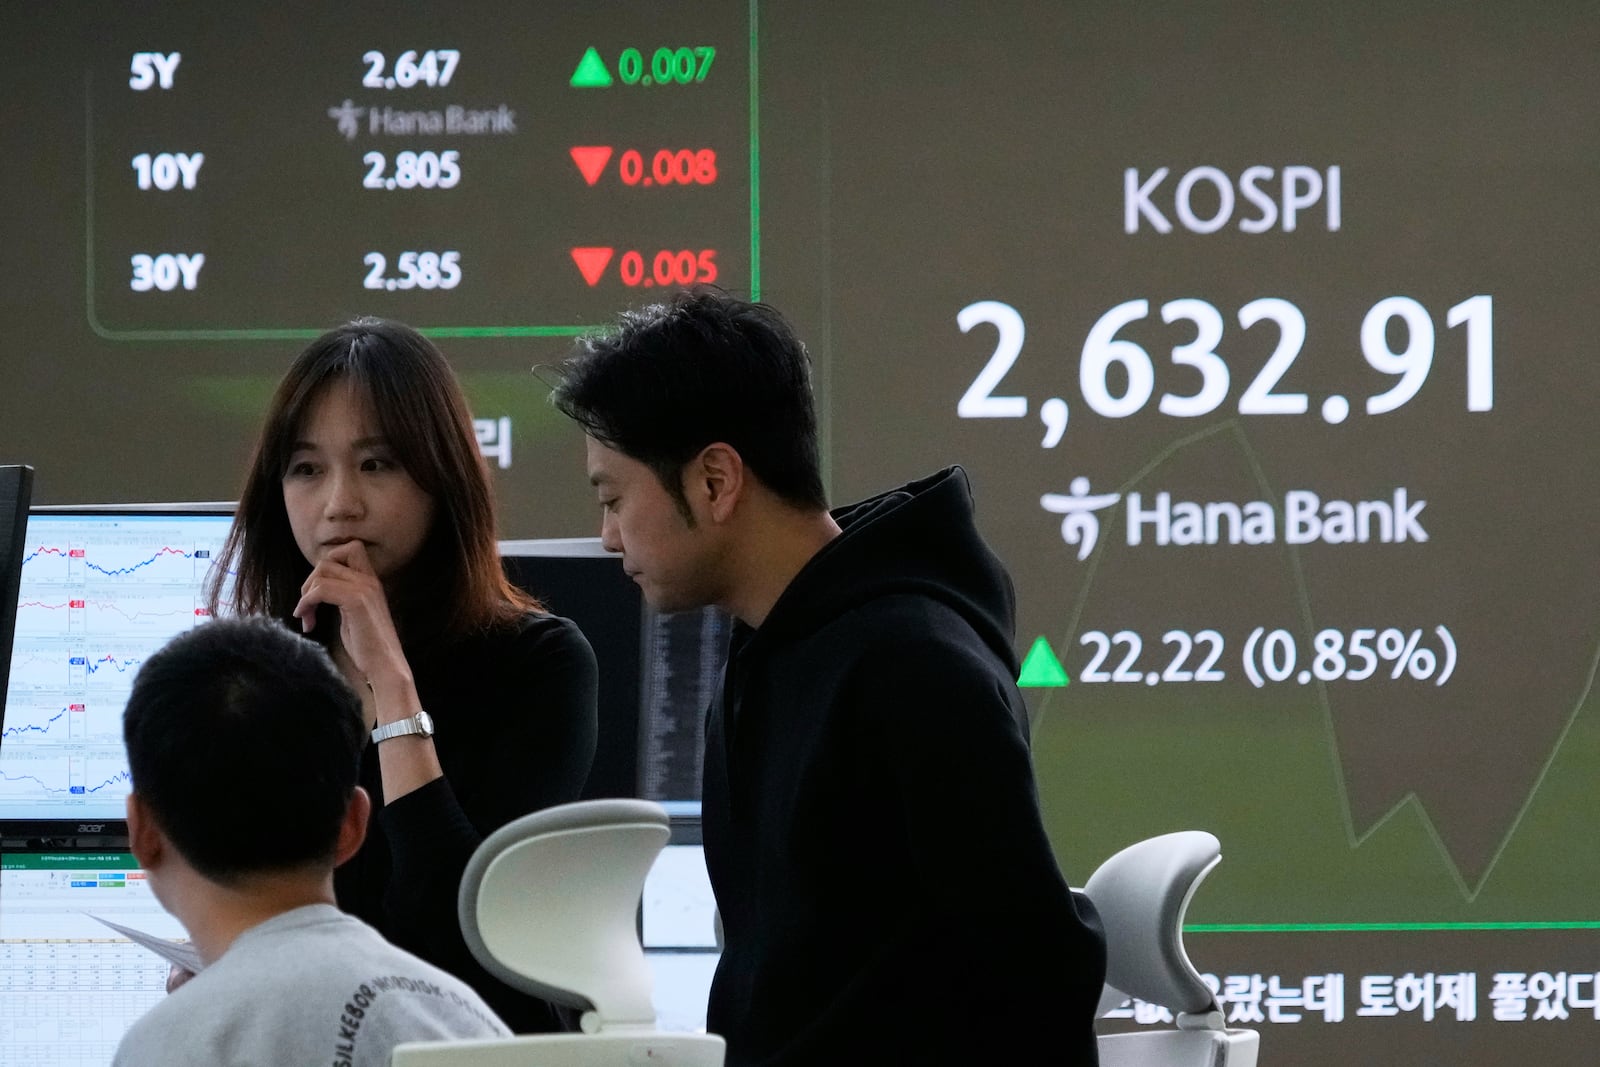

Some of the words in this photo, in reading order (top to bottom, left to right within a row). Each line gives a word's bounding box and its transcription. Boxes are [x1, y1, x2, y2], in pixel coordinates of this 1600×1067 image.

[130, 52, 181, 90] 5Y
[363, 50, 460, 89] 2.647
[619, 47, 715, 85] 0.007
[369, 106, 443, 135] Hana
[445, 104, 516, 134] Bank
[132, 153, 204, 191] 10Y
[363, 151, 460, 190] 2.805
[620, 148, 718, 187] 0.008
[1124, 165, 1341, 234] KOSPI
[131, 254, 205, 292] 30Y
[364, 251, 461, 291] 2.585
[620, 249, 718, 287] 0.005
[957, 295, 1493, 448] 2,632.91
[1126, 492, 1276, 546] Hana
[1284, 487, 1429, 545] Bank
[1079, 630, 1225, 687] 22.22
[1242, 625, 1458, 688] (0.85%)
[79, 824, 105, 832] acer
[1356, 972, 1477, 1022] 토허제
